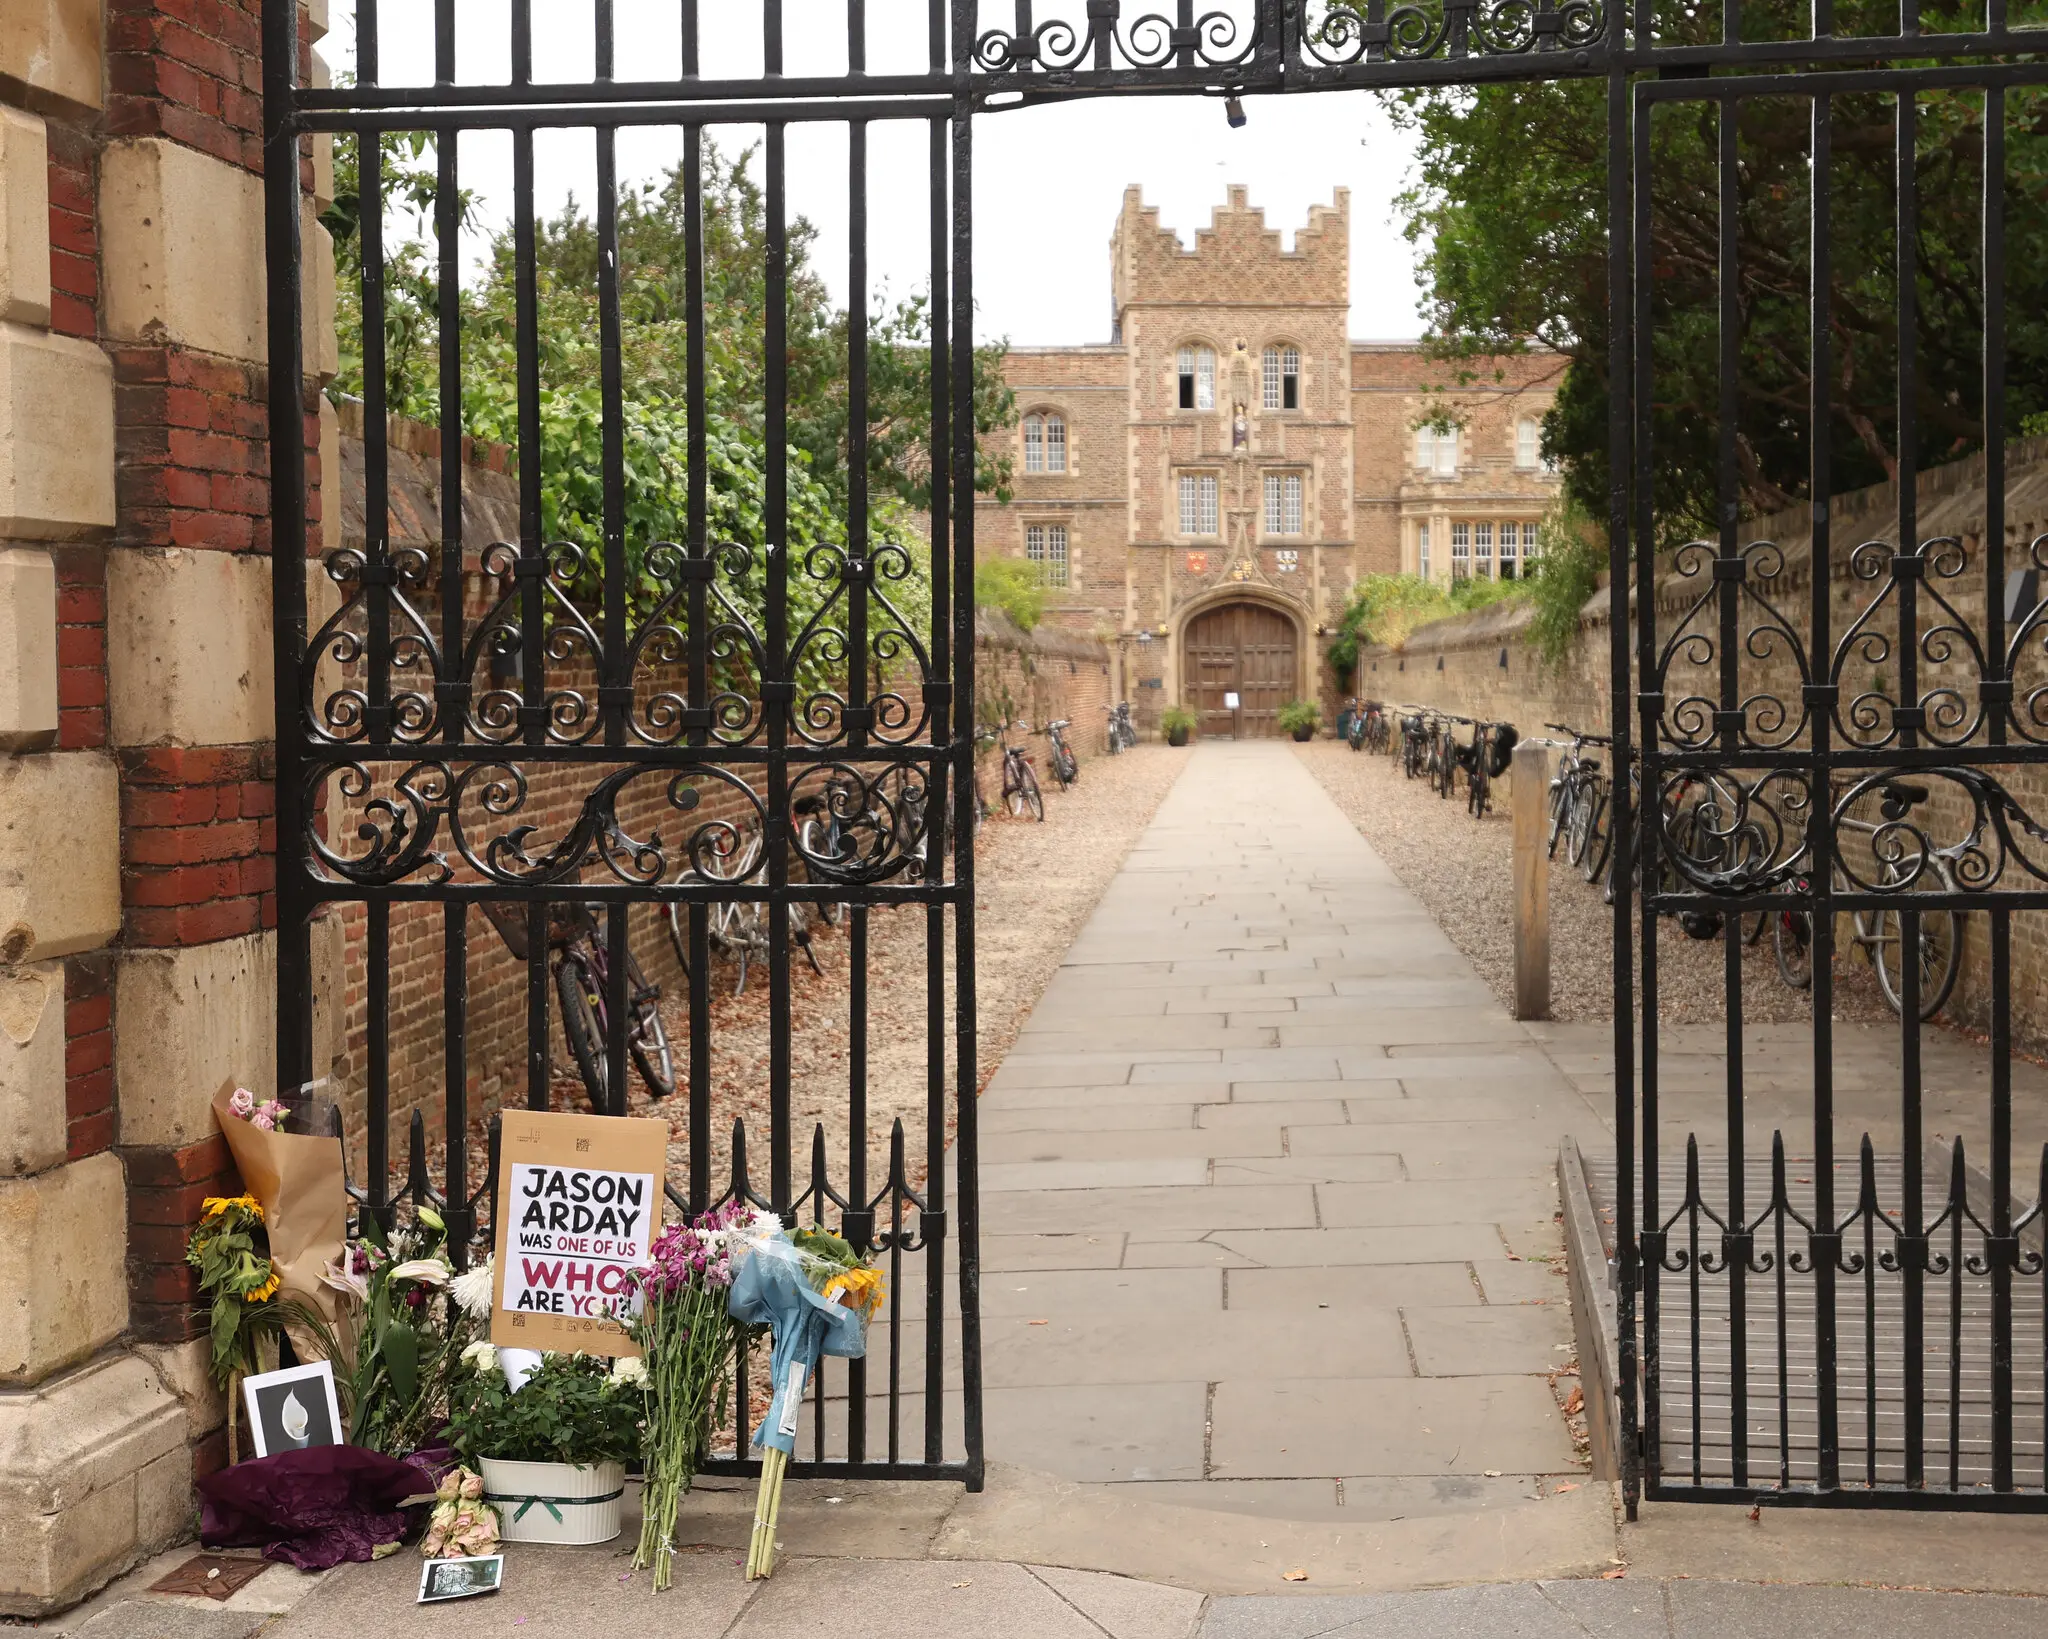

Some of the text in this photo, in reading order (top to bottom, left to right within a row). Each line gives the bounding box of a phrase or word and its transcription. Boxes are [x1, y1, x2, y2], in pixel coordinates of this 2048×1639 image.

[522, 1168, 643, 1207] JASON
[521, 1200, 641, 1238] ARDAY
[520, 1233, 636, 1257] WAS ONE OF US
[522, 1257, 627, 1295] WHO
[517, 1289, 564, 1312] ARE
